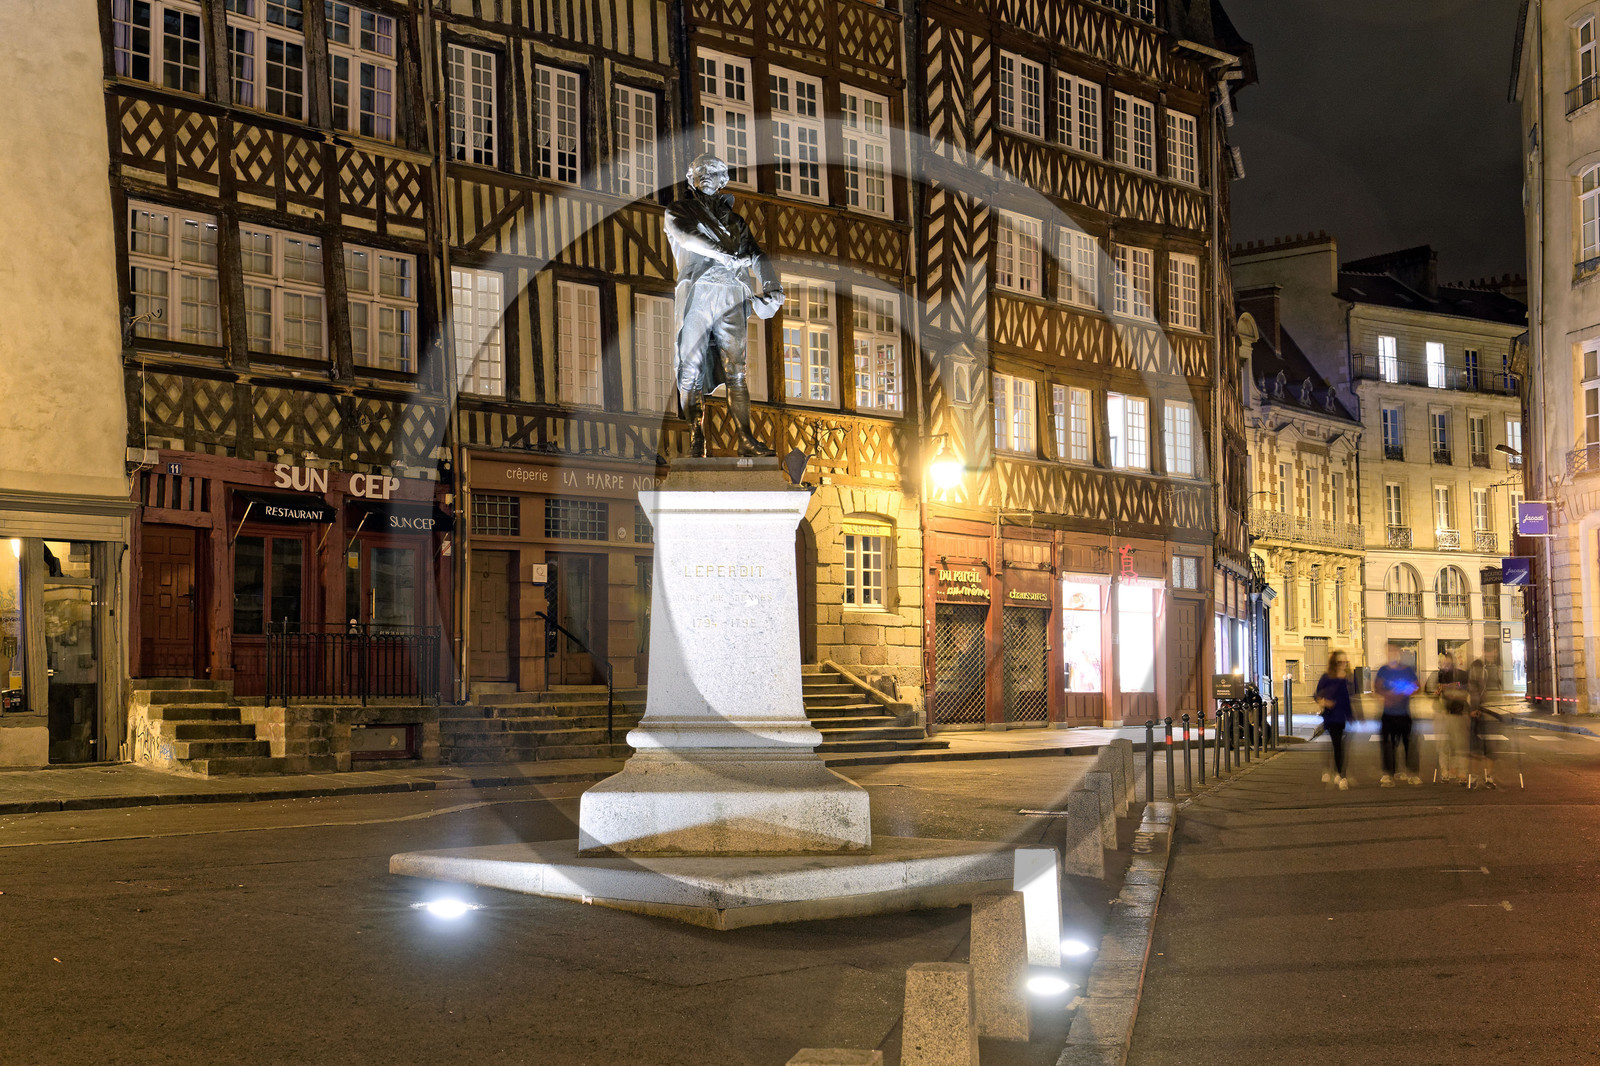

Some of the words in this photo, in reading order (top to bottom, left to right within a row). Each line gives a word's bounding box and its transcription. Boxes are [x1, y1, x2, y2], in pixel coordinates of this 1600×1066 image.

[170, 464, 179, 474] 11
[274, 463, 329, 494] SUN
[349, 473, 400, 500] CEP
[506, 467, 548, 483] crêperie
[563, 470, 578, 488] LA
[586, 472, 624, 490] HARPE
[632, 475, 662, 491] NOIR
[265, 505, 324, 520] RESTAURANT
[389, 515, 413, 529] SUN
[413, 517, 436, 530] CEP
[684, 565, 765, 578] LEPERDIT
[1009, 588, 1048, 601] chaussures
